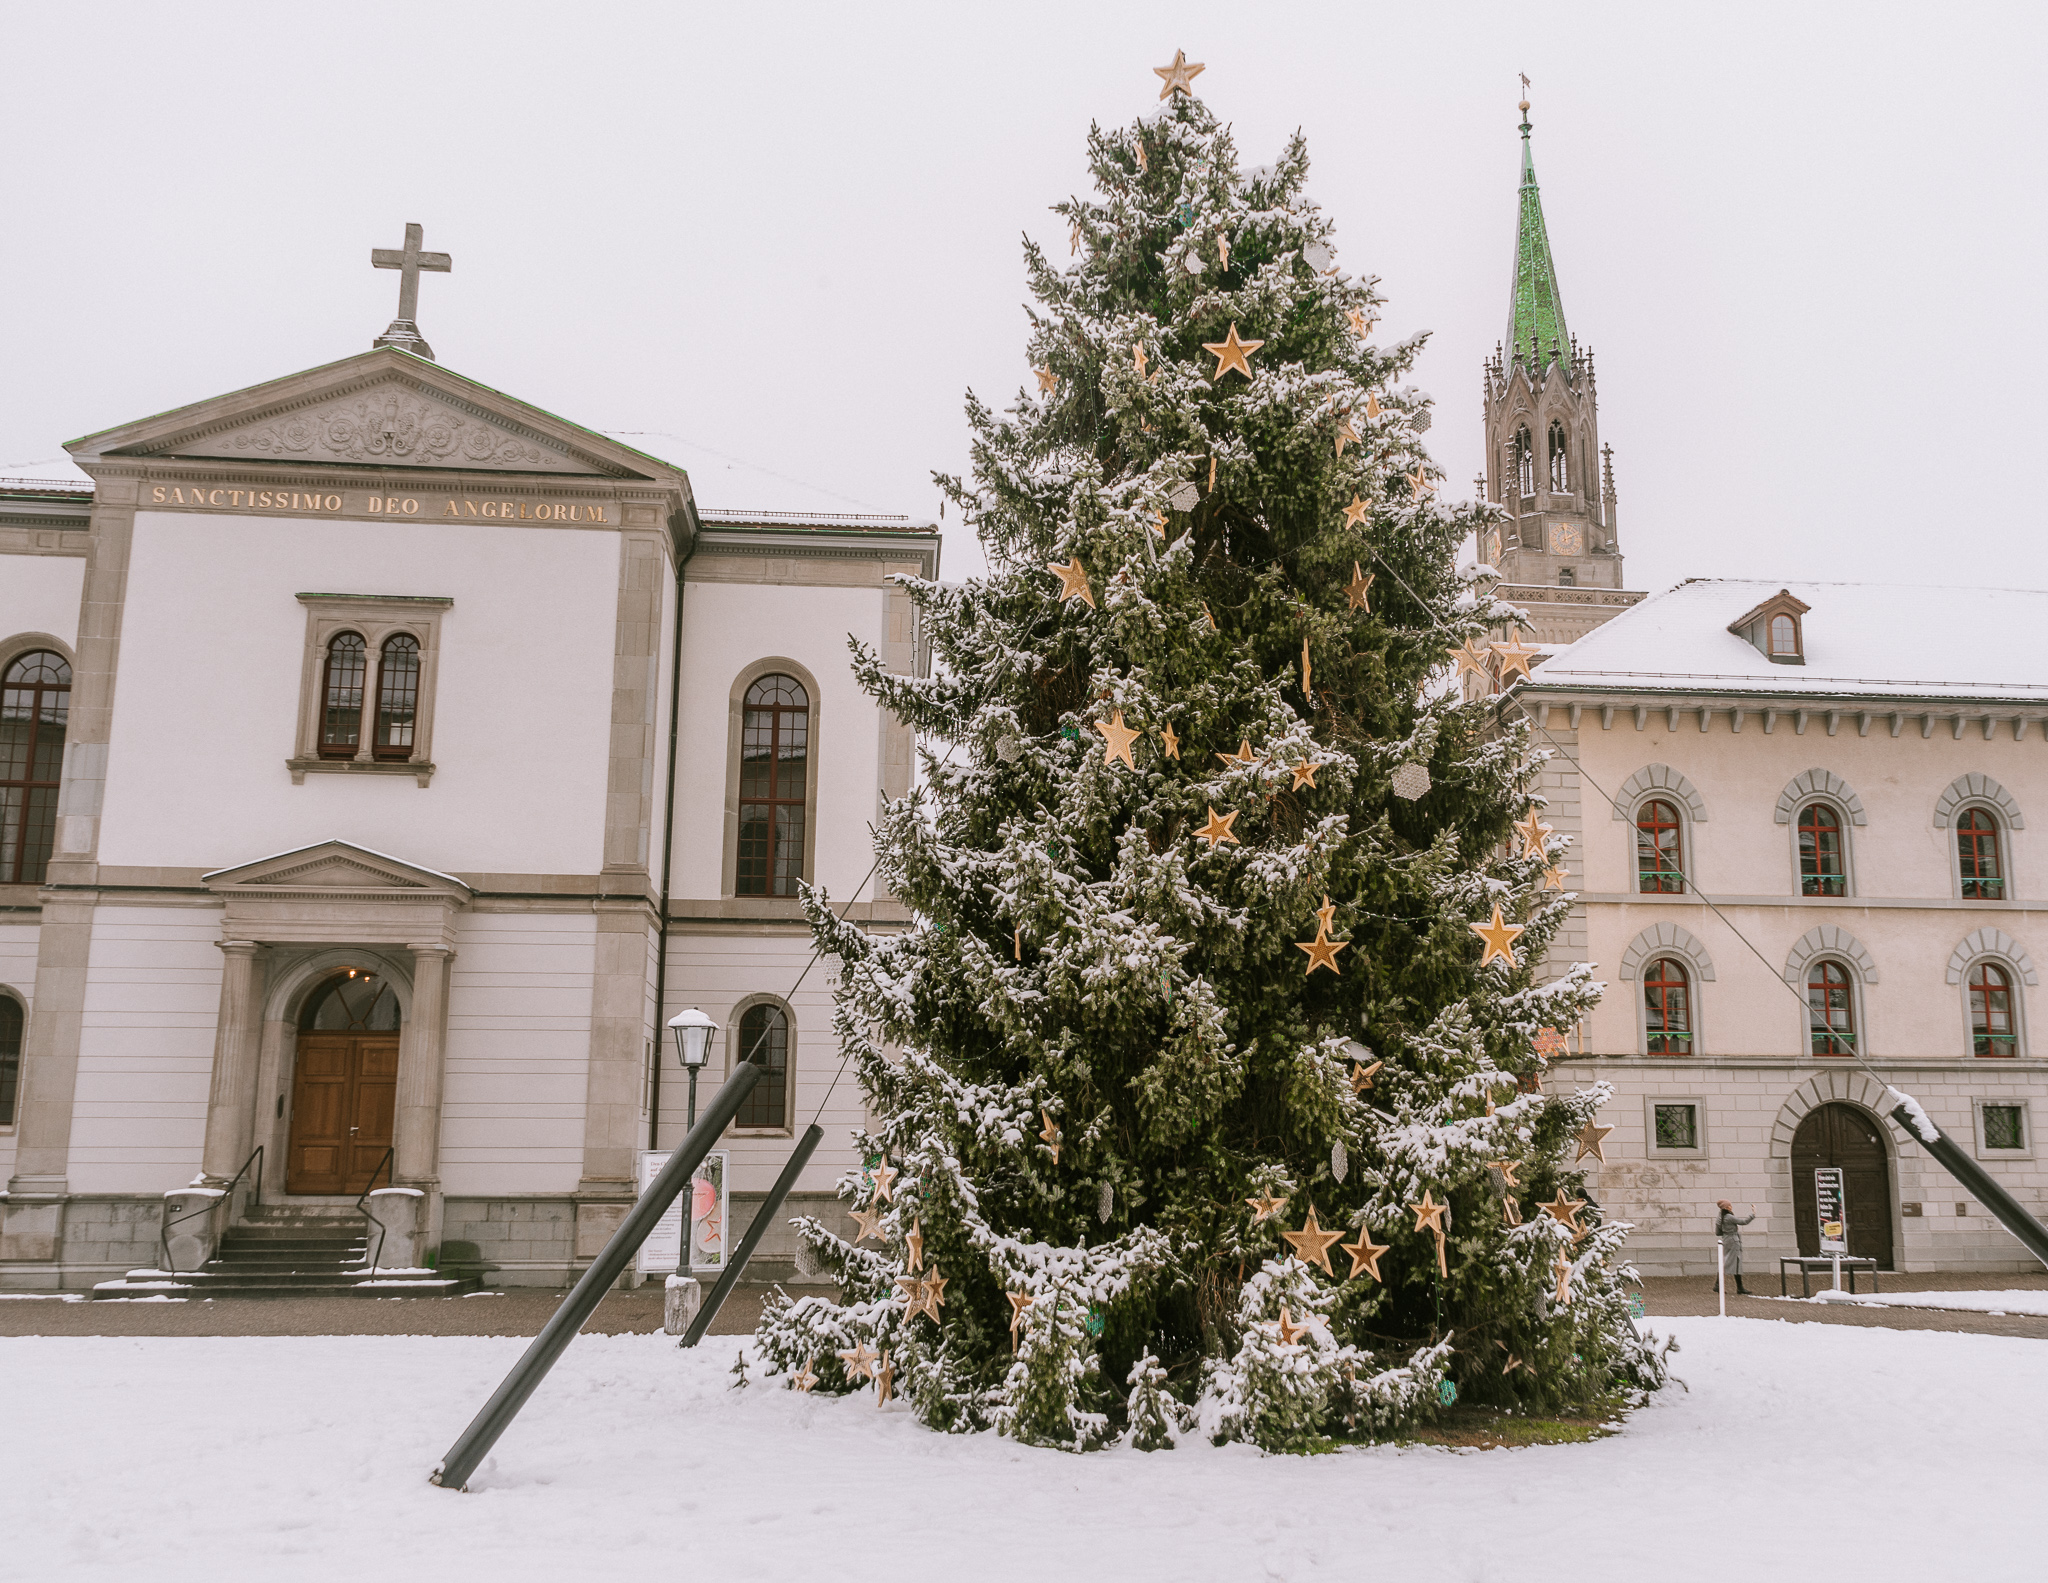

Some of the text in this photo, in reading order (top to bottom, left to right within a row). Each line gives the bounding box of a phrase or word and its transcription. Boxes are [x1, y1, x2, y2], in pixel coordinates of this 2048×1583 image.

[152, 486, 609, 526] SANCTISSIMO DEO ANGELORUM.
